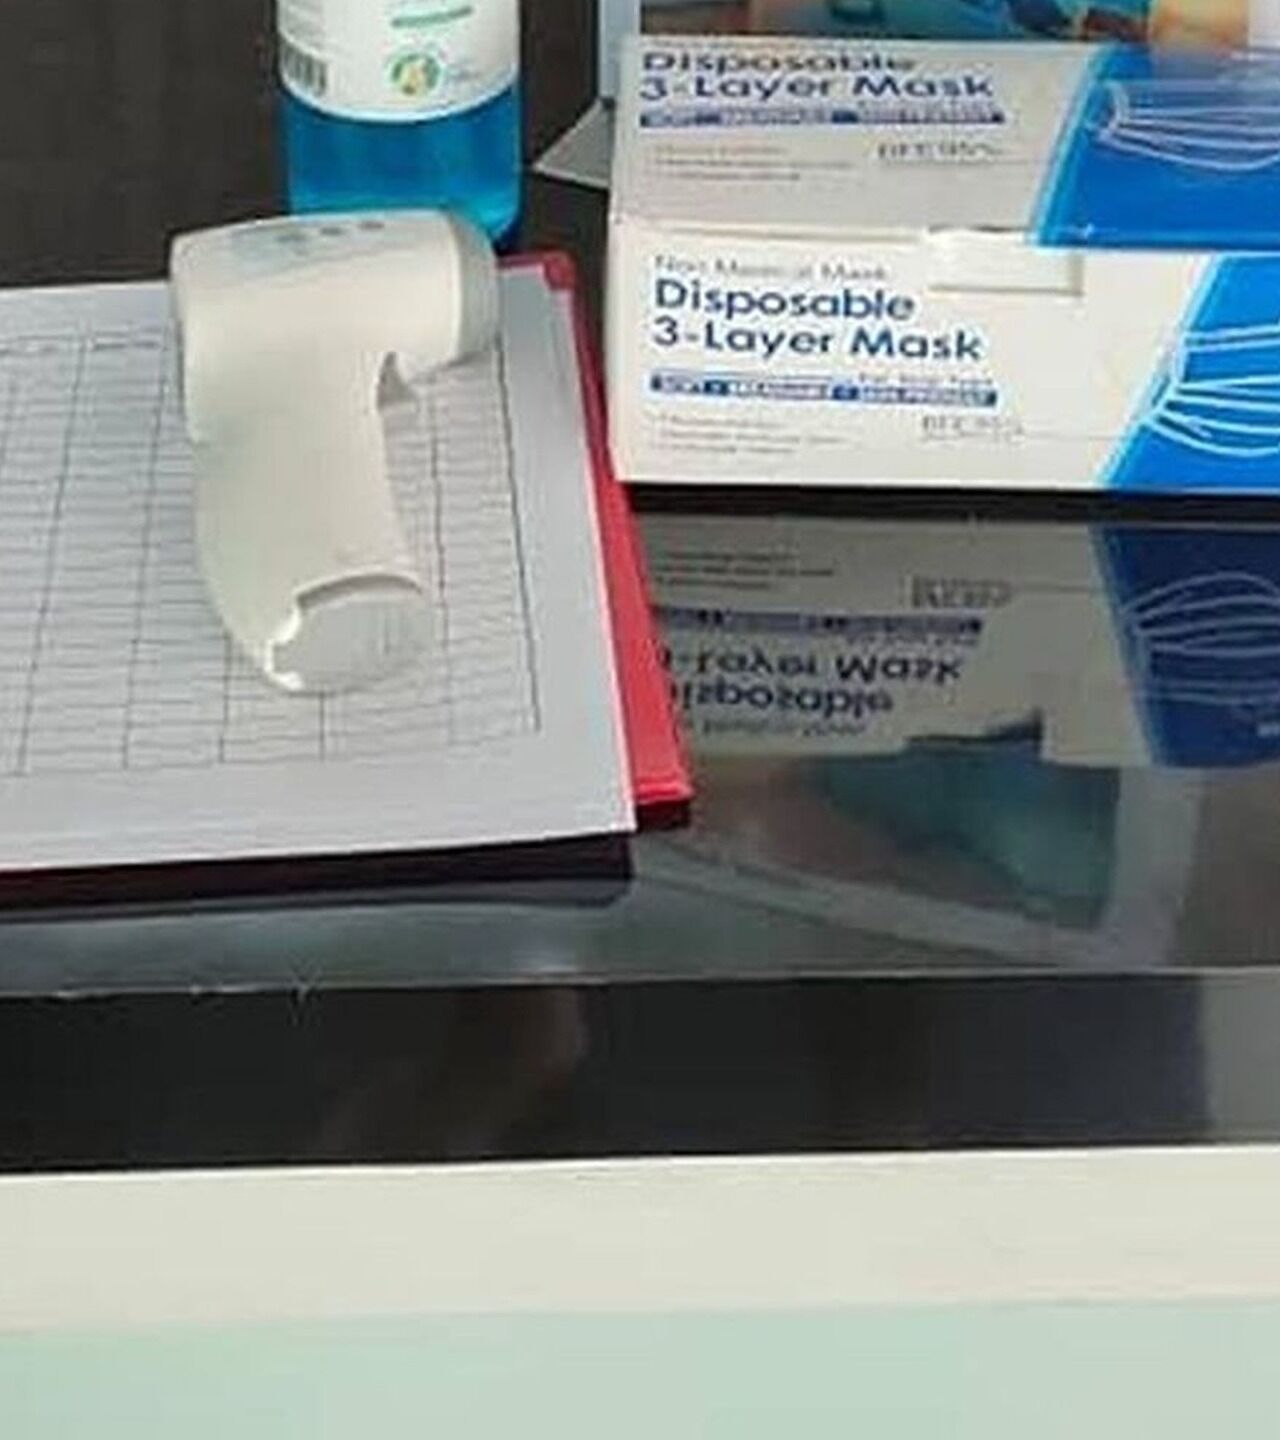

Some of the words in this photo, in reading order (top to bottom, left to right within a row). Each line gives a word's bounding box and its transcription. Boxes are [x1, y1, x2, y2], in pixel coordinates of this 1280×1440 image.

[642, 50, 917, 76] Disposable
[640, 74, 832, 101] 3-Layer
[852, 74, 994, 98] Mask
[654, 278, 916, 321] Disposable
[653, 315, 836, 358] 3-Layer
[849, 326, 985, 361] Mask
